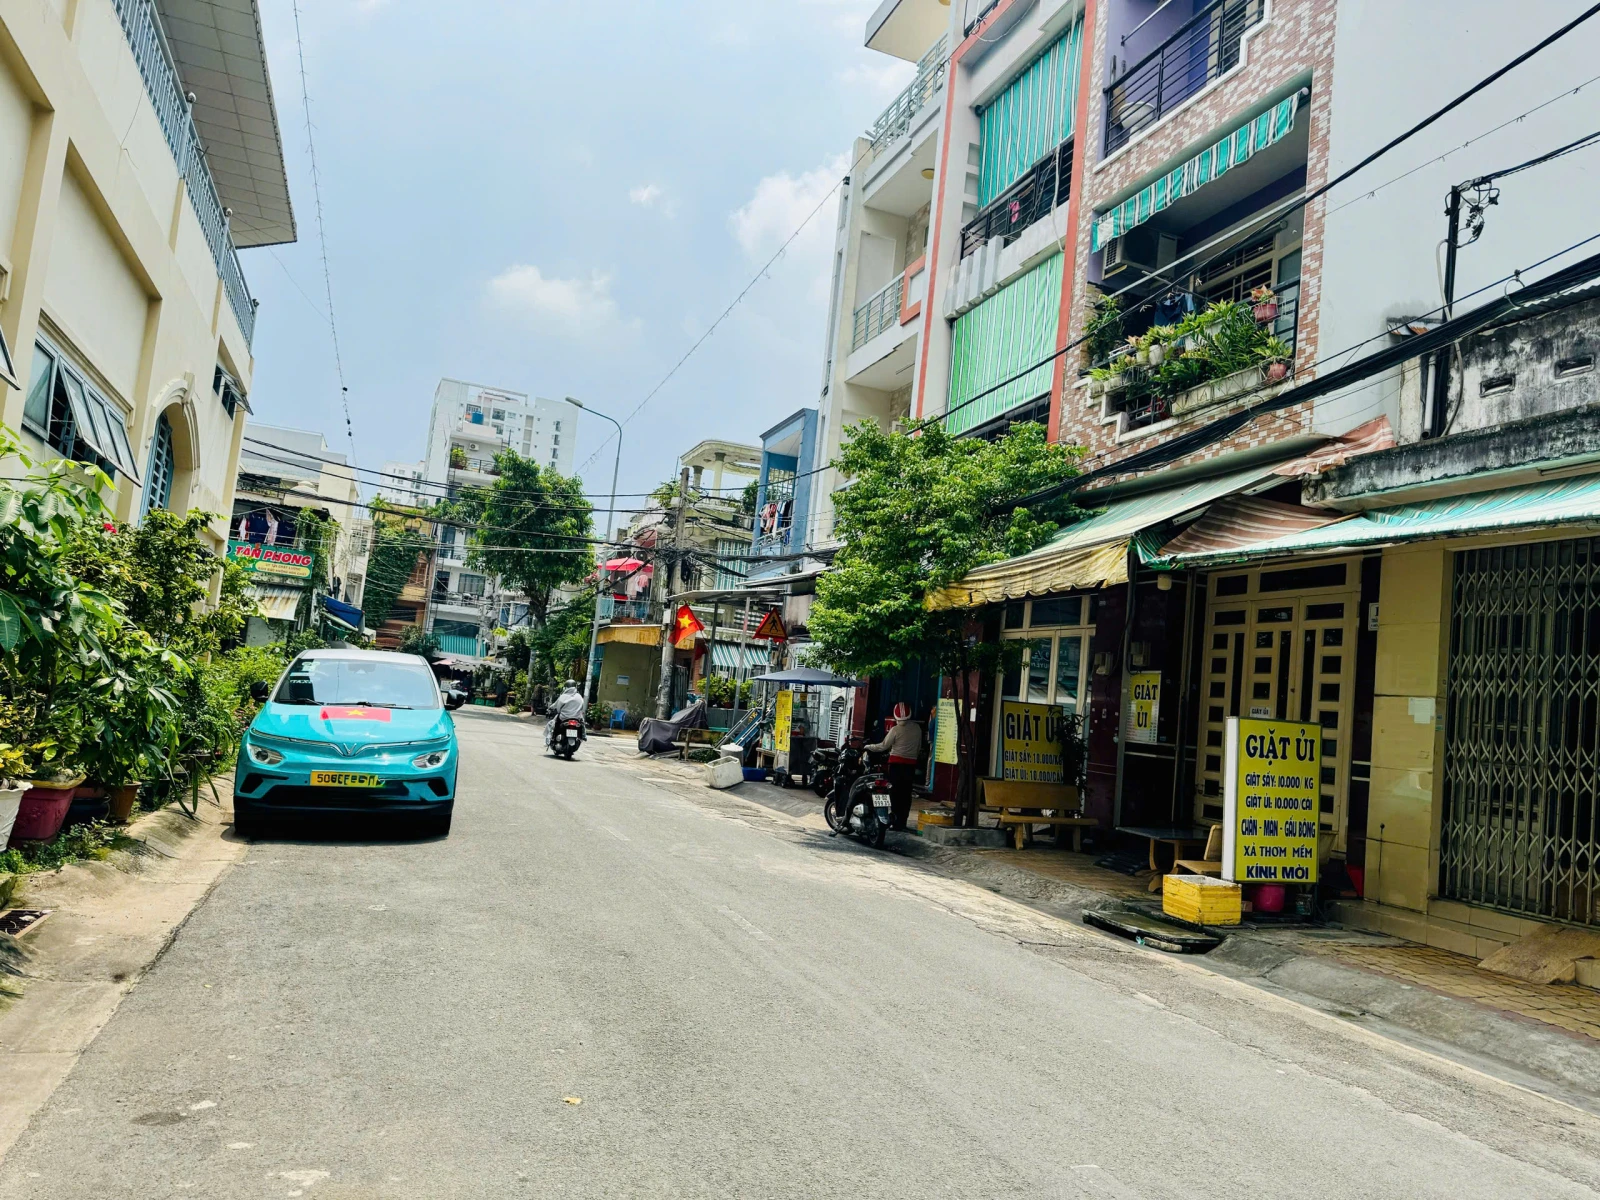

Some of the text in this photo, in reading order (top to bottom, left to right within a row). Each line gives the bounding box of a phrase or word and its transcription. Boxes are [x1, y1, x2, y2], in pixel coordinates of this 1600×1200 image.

[235, 544, 312, 566] TÂN PHONG
[1137, 705, 1148, 728] ỦI
[1006, 709, 1041, 747] GIẶT
[1245, 728, 1315, 766] GIẶT ỦI
[1245, 771, 1261, 789] GIẶT
[1262, 770, 1276, 788] SẤY:
[1304, 776, 1314, 789] KG
[1245, 793, 1262, 811] GIẶT
[1263, 792, 1272, 809] ỦI:
[1284, 815, 1297, 838] GẤU
[1298, 817, 1316, 838] BÔNG
[1243, 842, 1313, 858] XẢ THƠM MỀM
[1246, 863, 1309, 880] KÍNH MỜI
